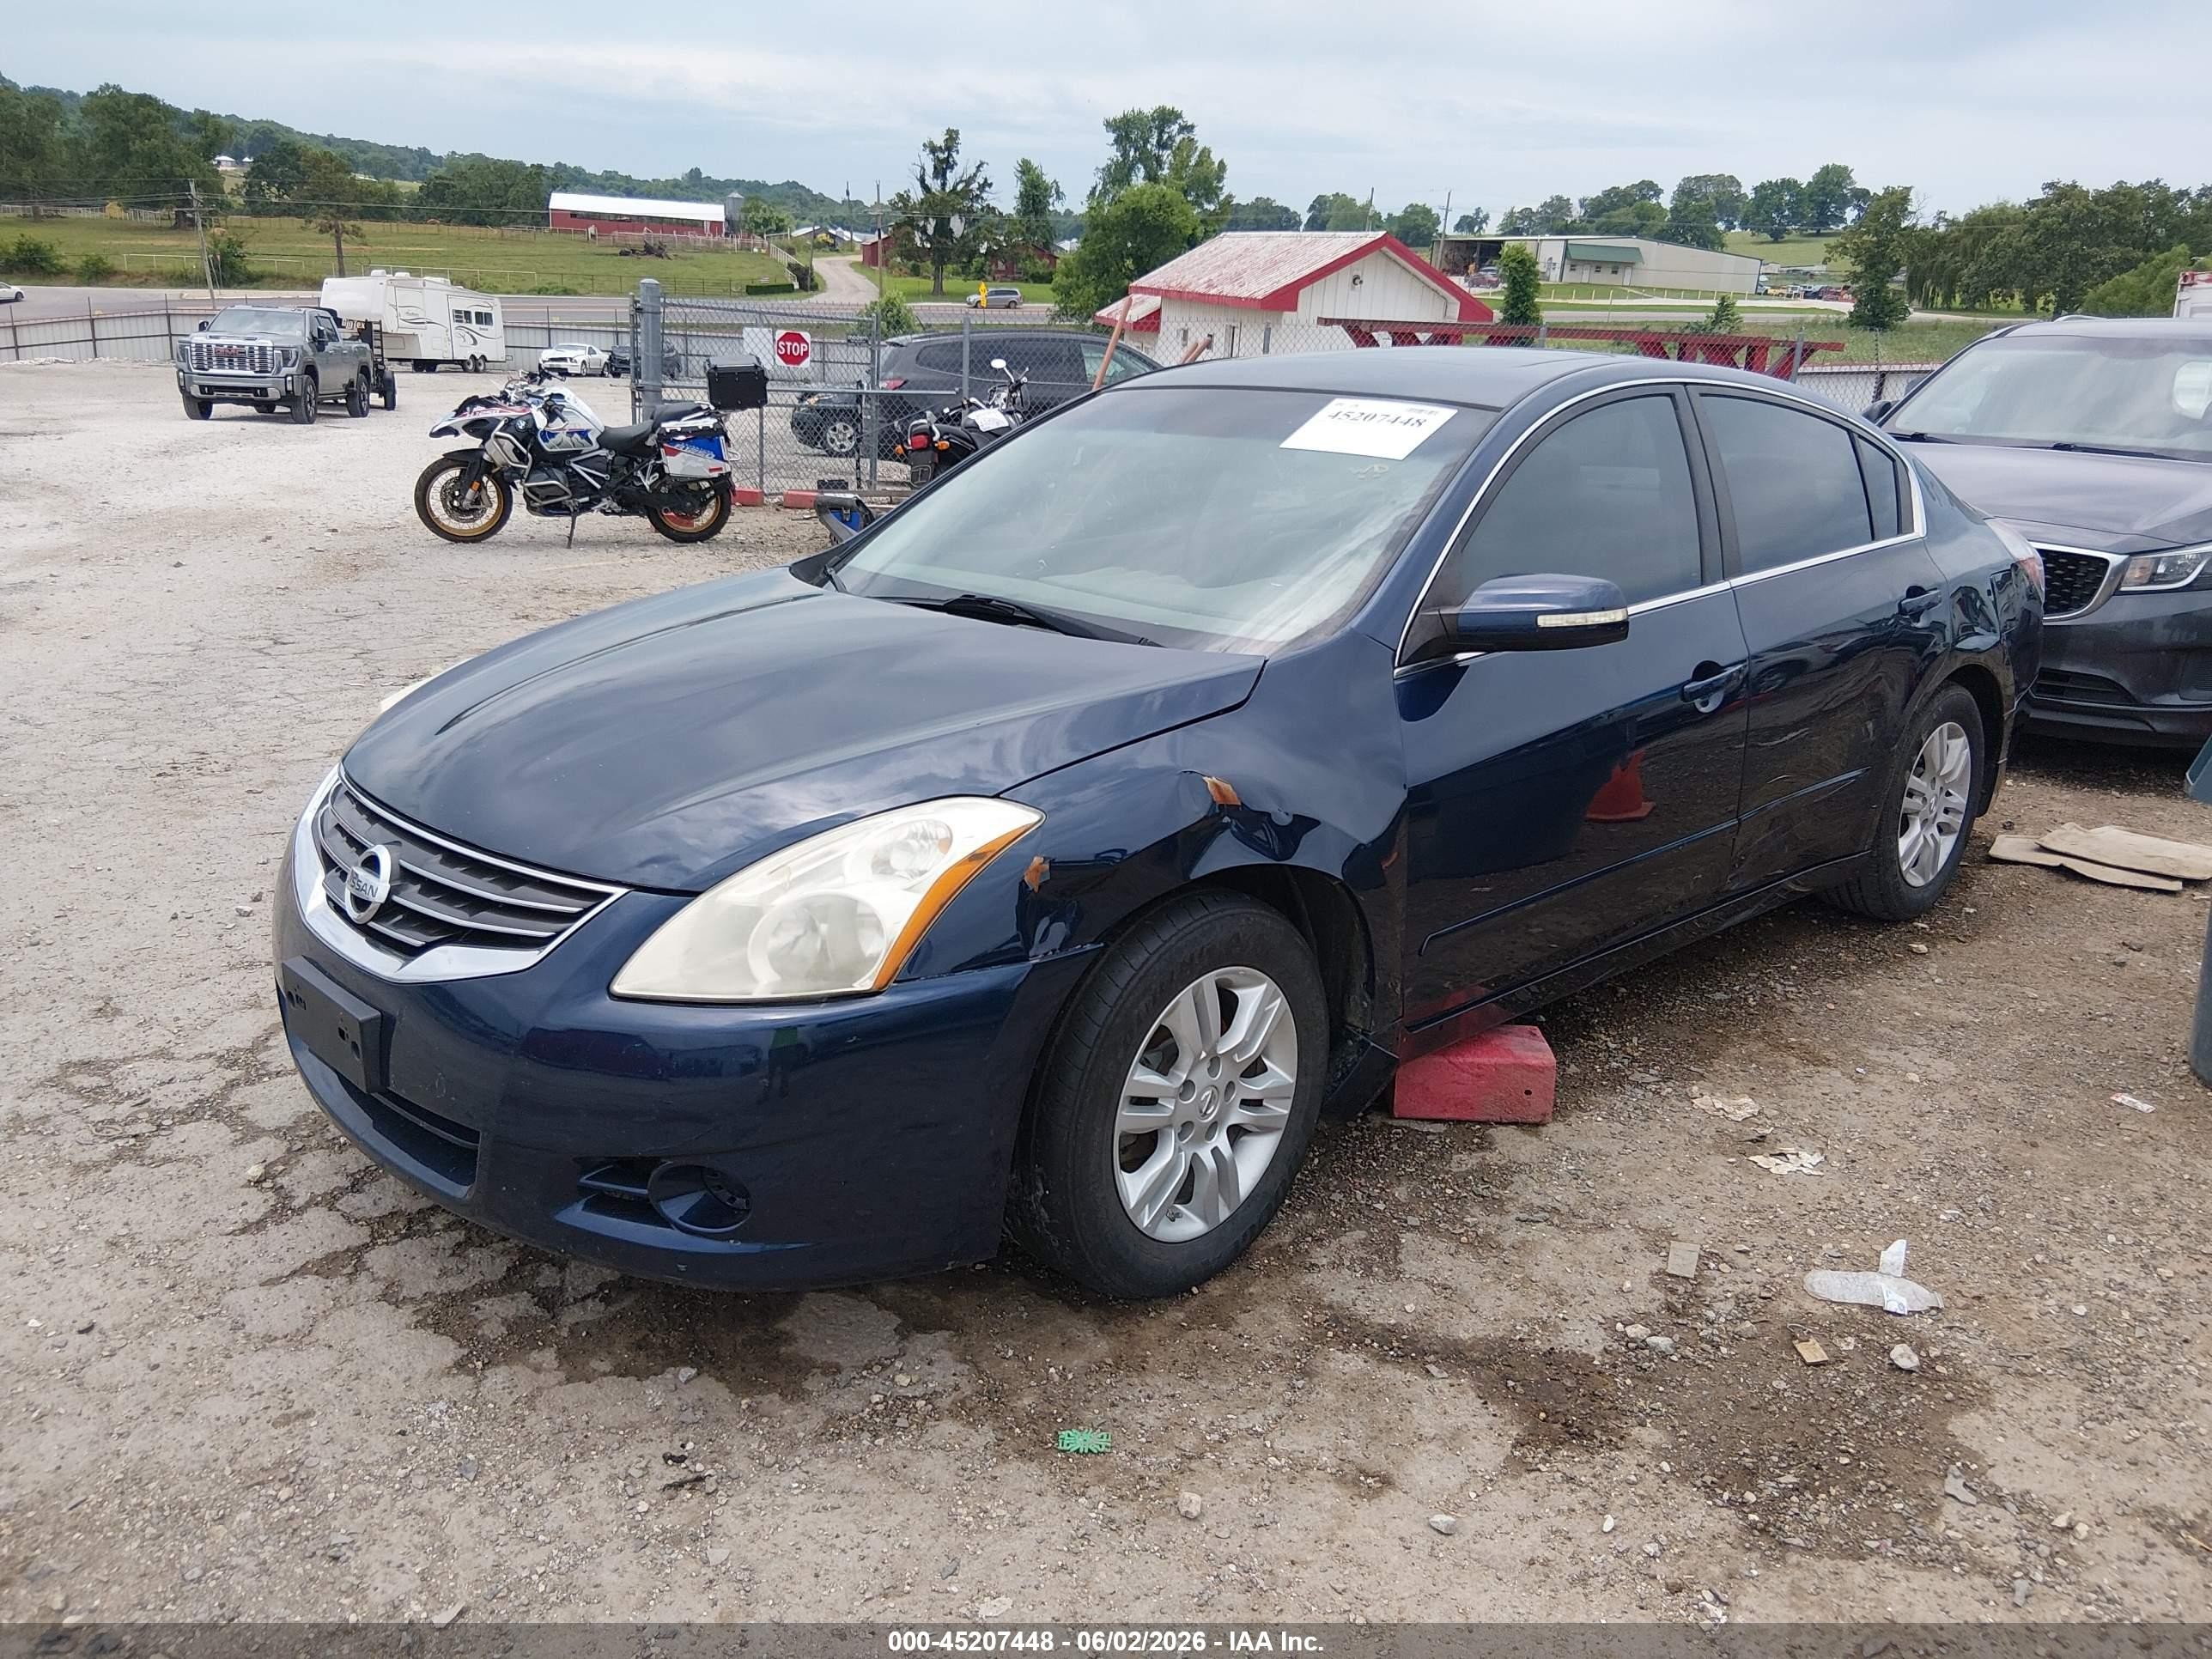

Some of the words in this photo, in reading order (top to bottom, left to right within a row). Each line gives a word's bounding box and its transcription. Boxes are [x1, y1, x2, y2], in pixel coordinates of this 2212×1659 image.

[215, 347, 246, 357] GMC
[777, 341, 808, 356] STOP
[1328, 410, 1427, 428] 45207448
